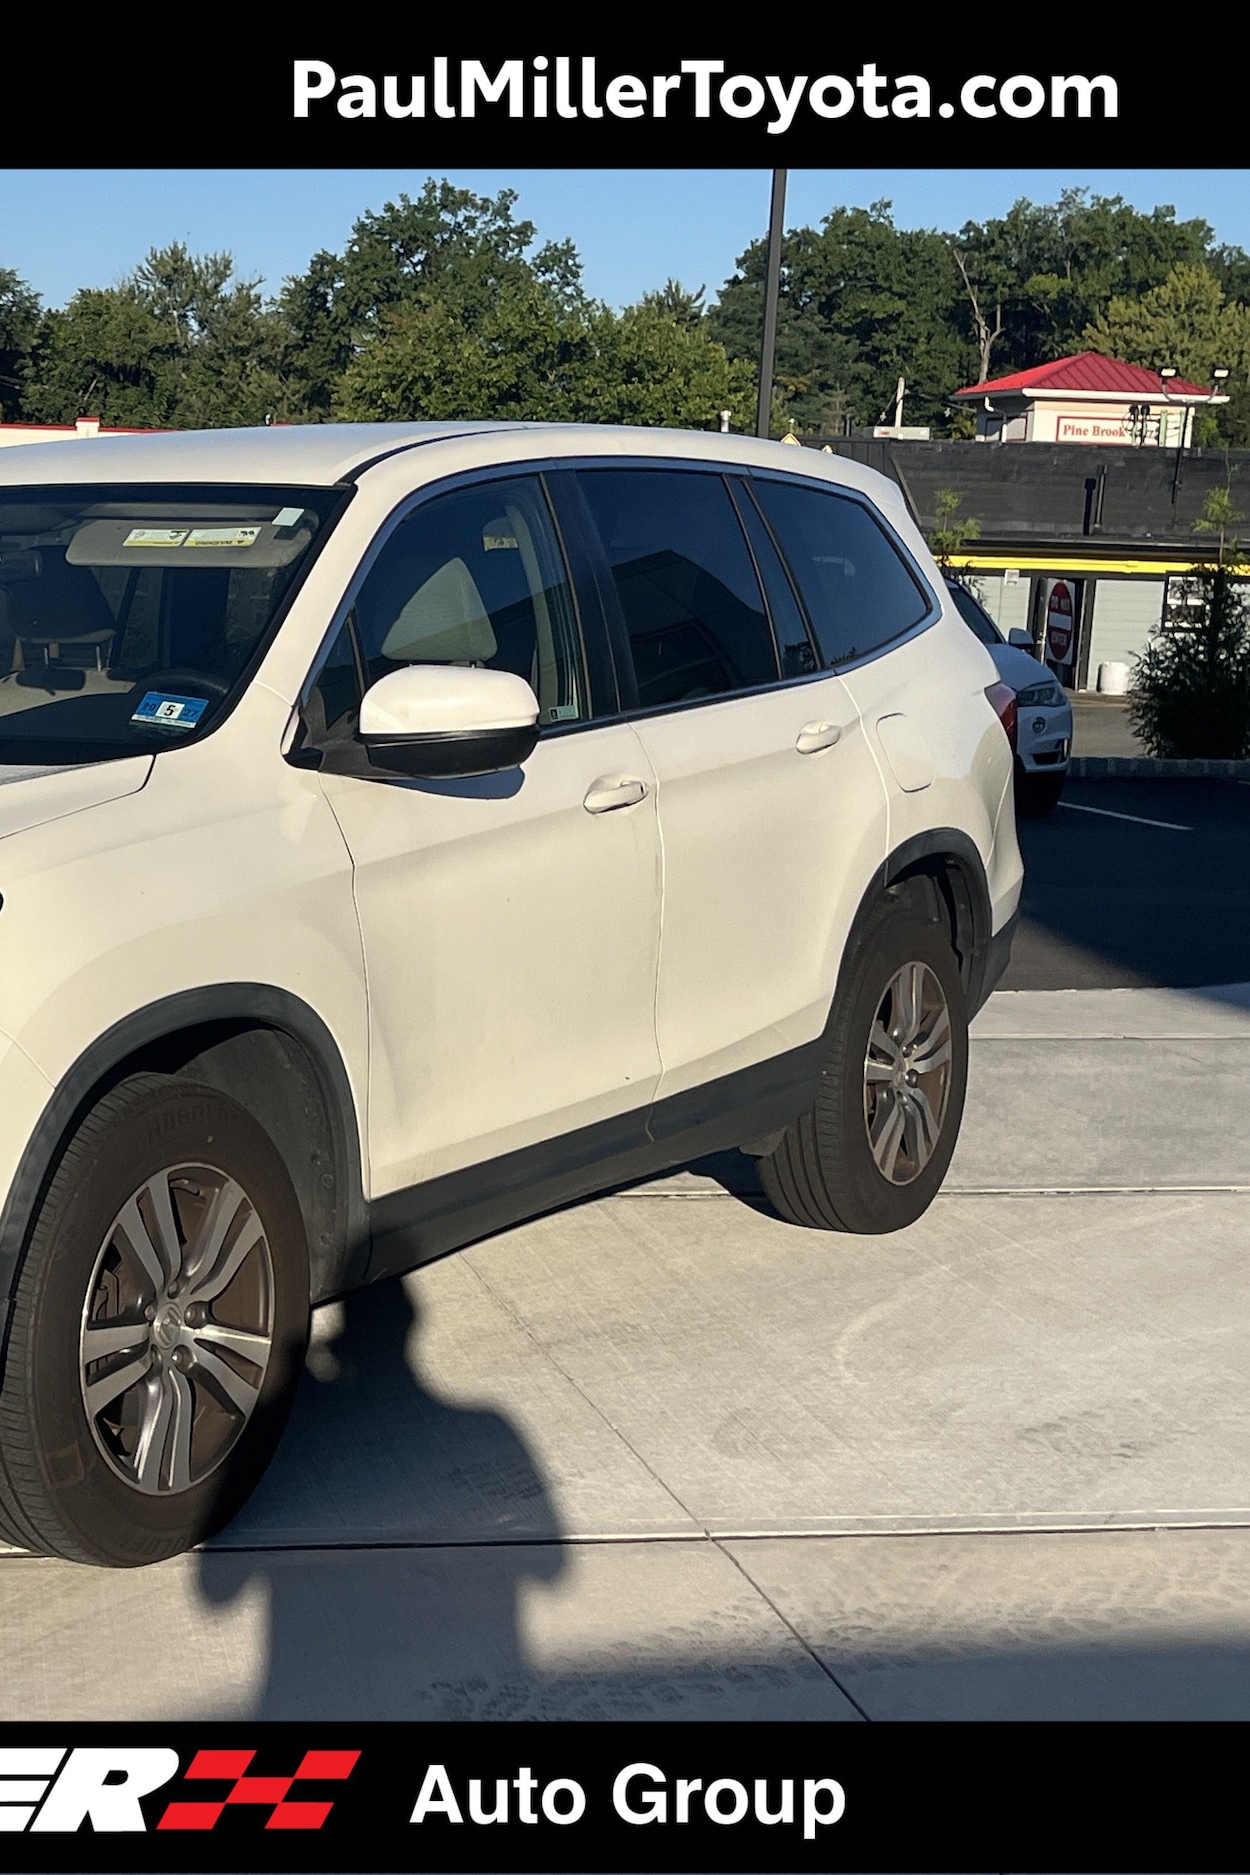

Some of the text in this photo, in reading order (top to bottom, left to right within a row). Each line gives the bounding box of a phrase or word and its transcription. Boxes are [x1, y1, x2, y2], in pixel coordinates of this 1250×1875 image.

[1063, 424, 1089, 436] Pine
[1092, 425, 1126, 437] Brook
[164, 704, 177, 717] 5
